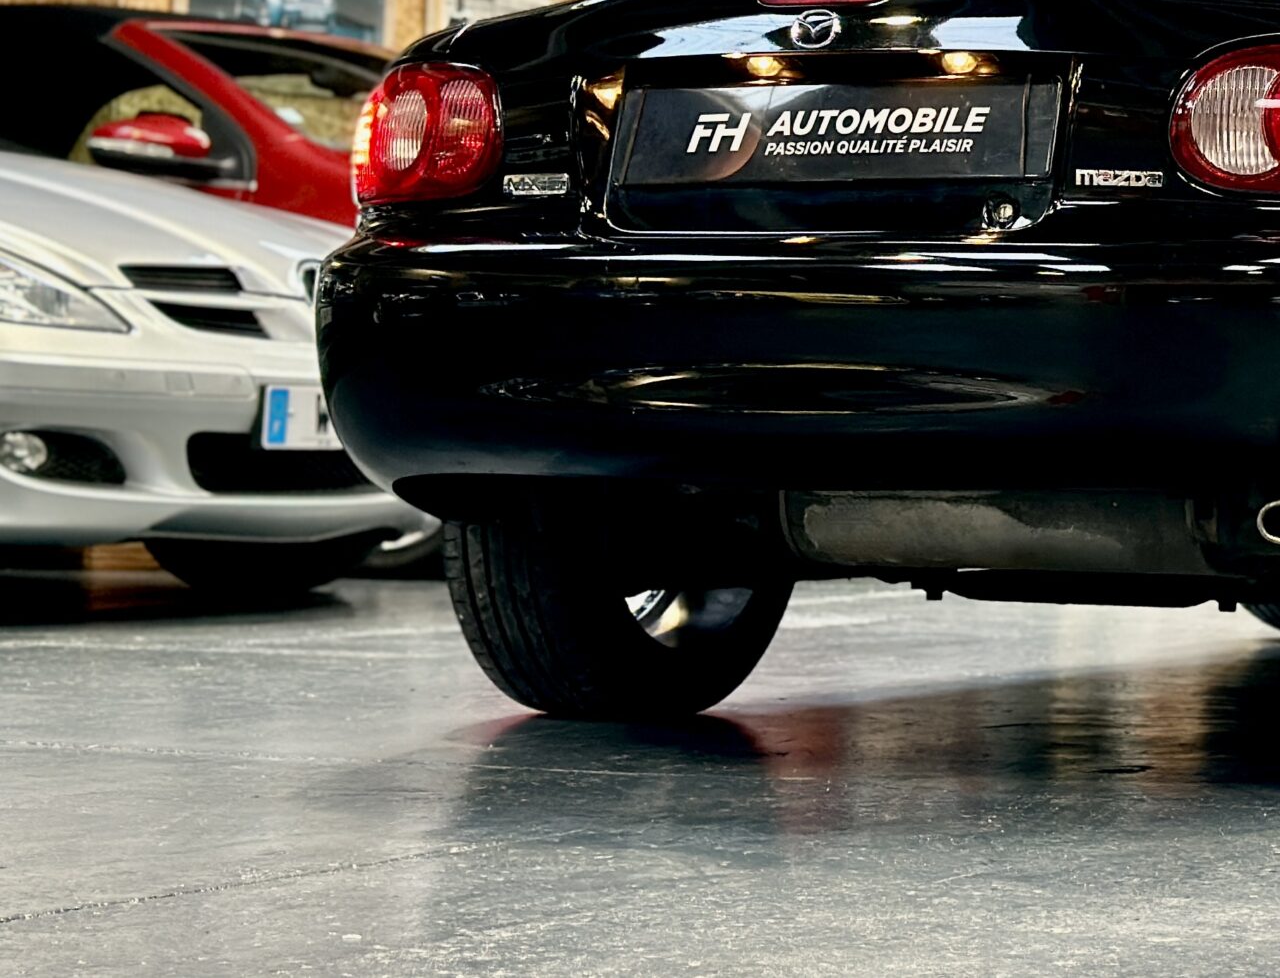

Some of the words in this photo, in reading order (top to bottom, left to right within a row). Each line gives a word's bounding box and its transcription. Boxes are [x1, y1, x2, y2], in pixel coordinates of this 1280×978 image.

[686, 112, 752, 153] FH
[766, 106, 991, 137] AUTOMOBILE
[764, 140, 833, 156] PASSION
[837, 137, 906, 155] QUALITÉ
[908, 138, 974, 154] PLAISIR
